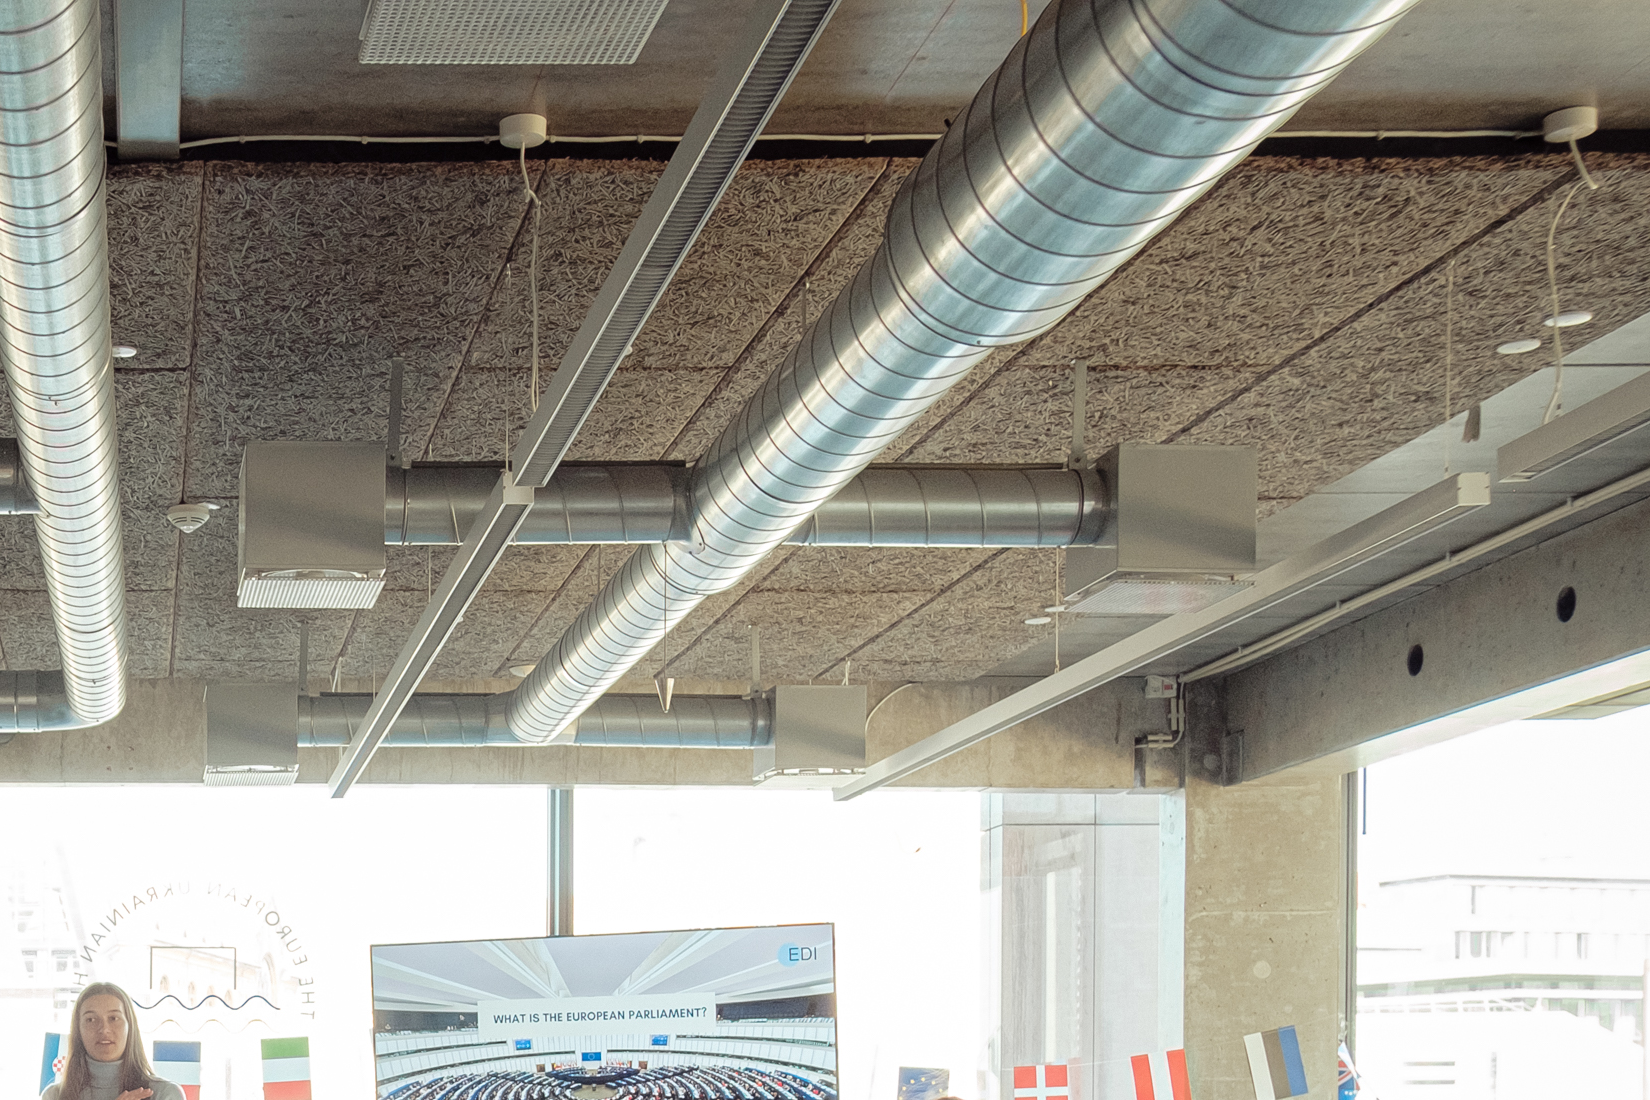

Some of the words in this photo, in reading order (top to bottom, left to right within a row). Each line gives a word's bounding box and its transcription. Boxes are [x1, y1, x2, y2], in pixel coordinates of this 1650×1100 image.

[788, 946, 817, 961] EDI
[493, 1013, 526, 1024] WHAT
[529, 1013, 540, 1023] IS
[542, 1012, 563, 1022] THE
[566, 1010, 625, 1022] EUROPEAN
[628, 1006, 707, 1020] PARLIAMENT?
